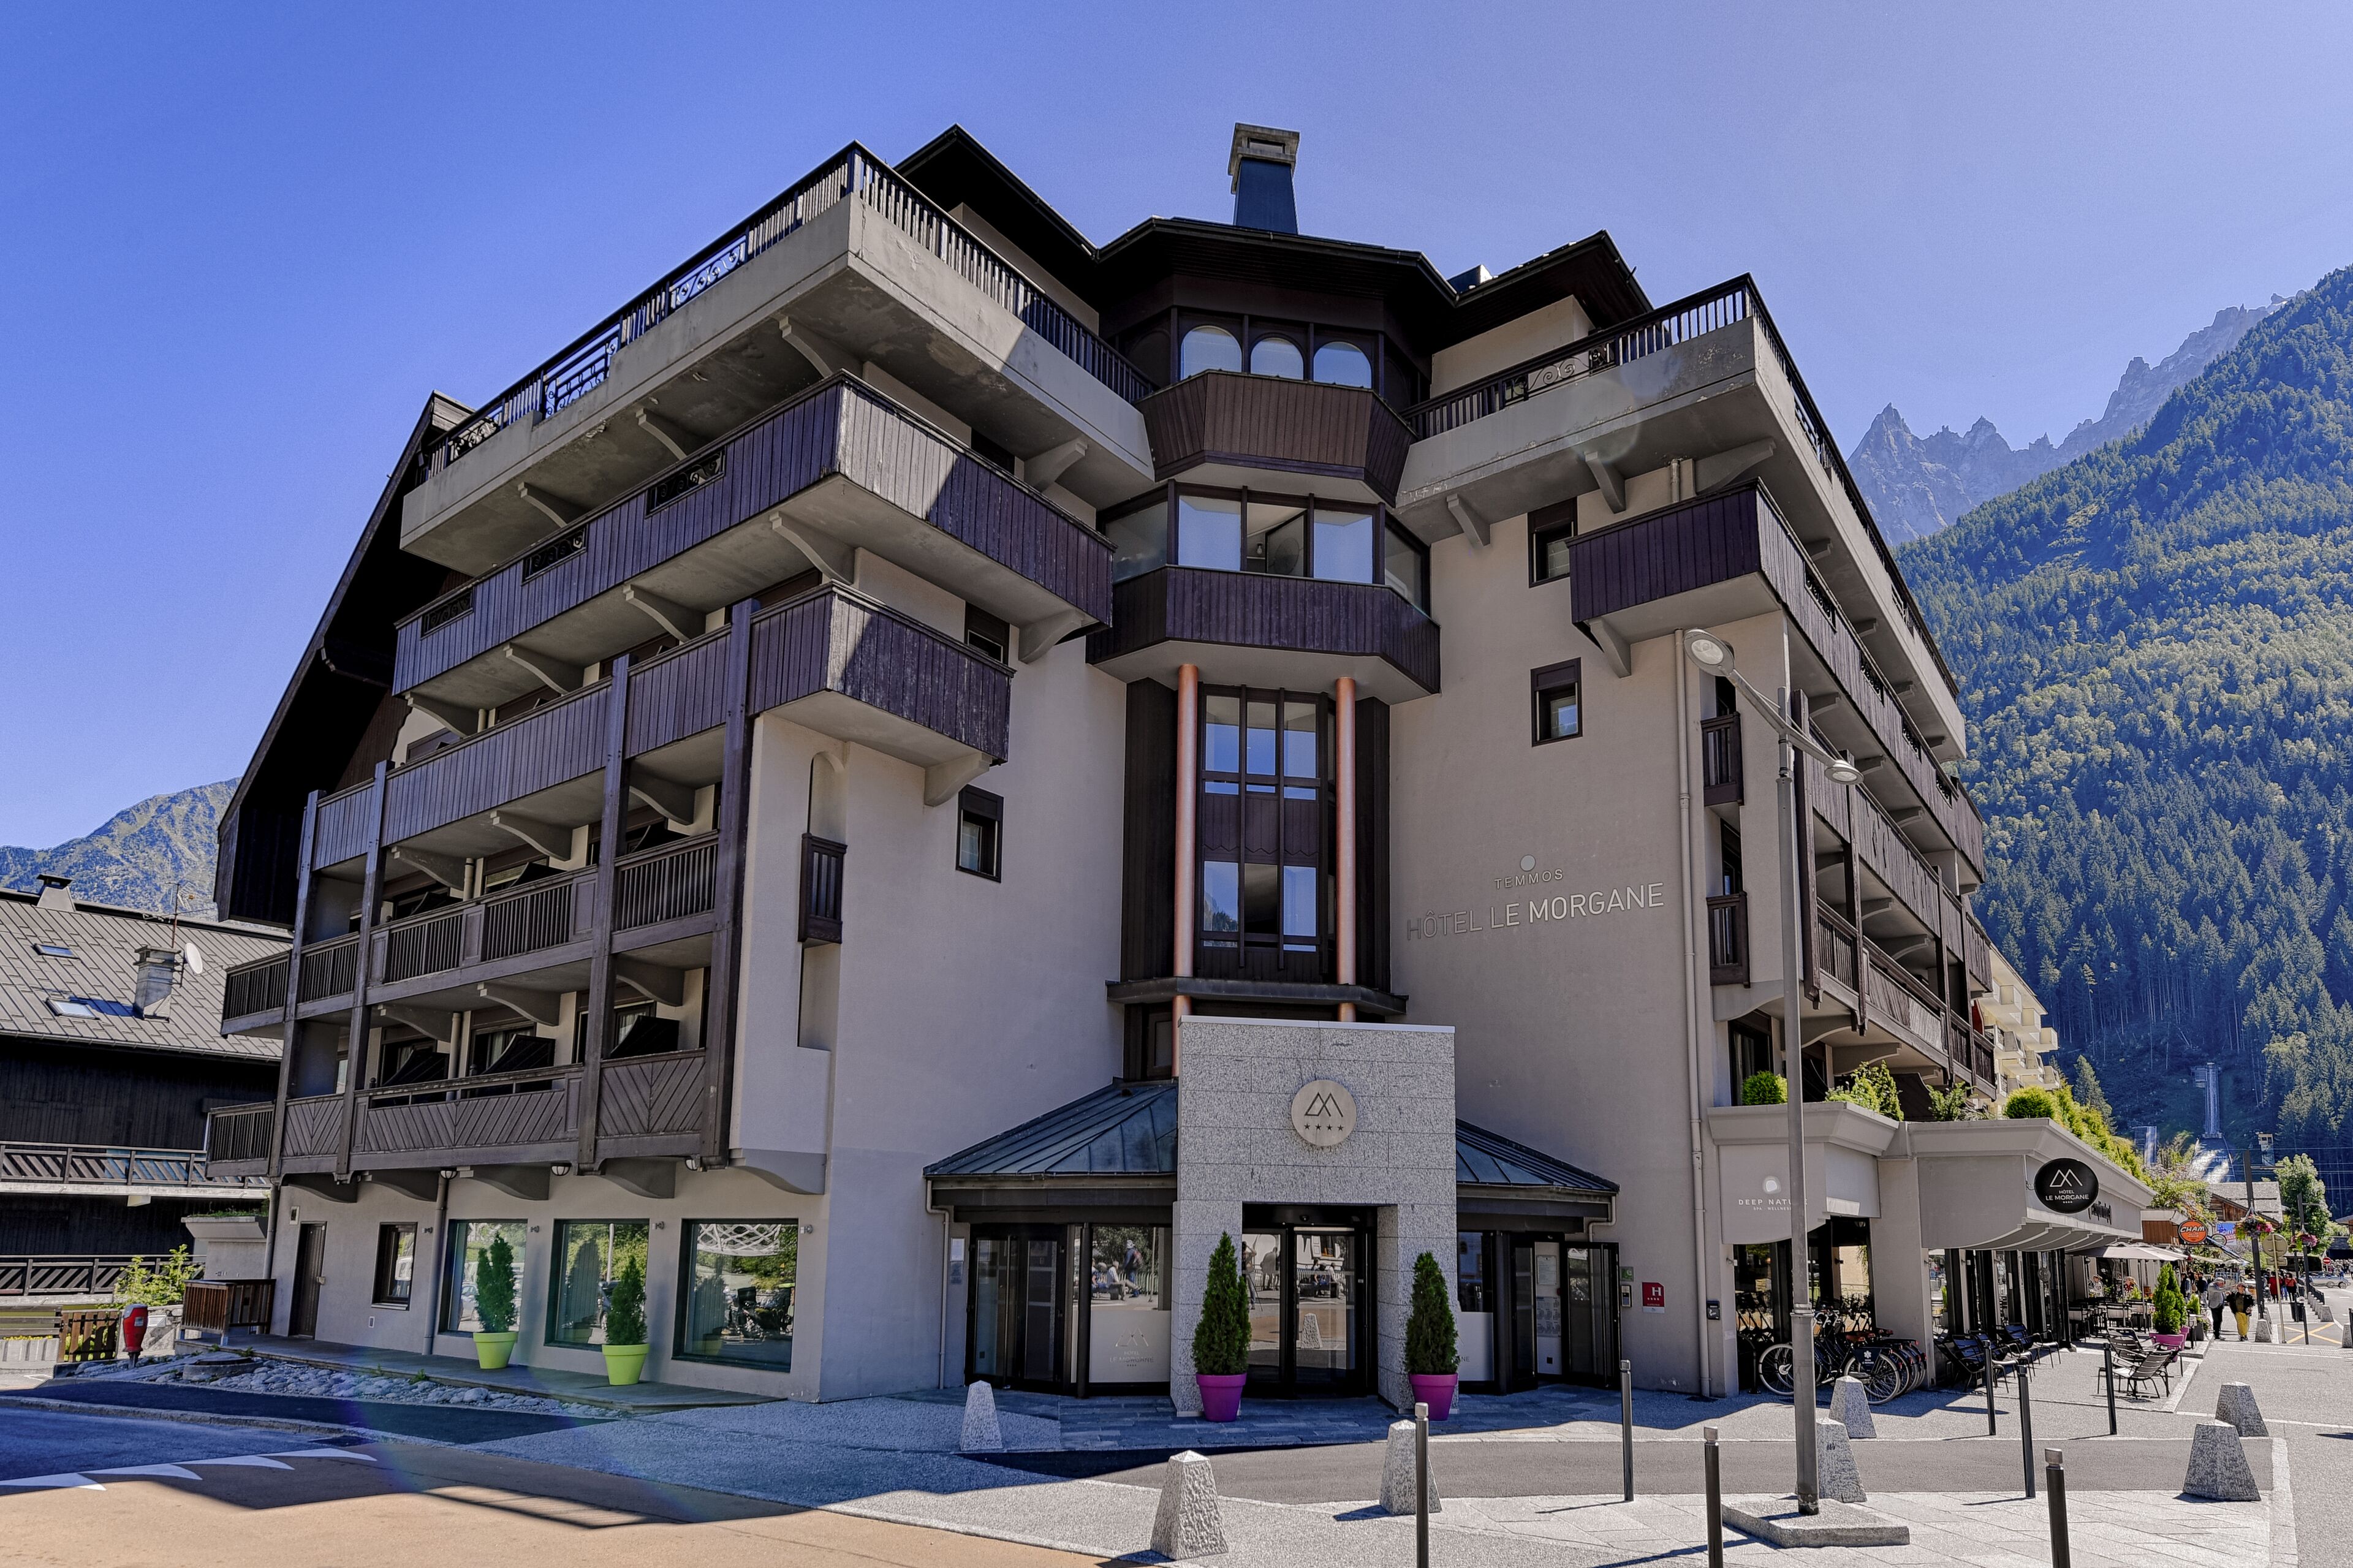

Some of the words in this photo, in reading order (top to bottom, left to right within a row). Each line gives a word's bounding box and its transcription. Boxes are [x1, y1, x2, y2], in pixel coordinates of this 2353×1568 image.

[1494, 869, 1563, 889] TEMMOS
[1407, 910, 1483, 941] HÔTEL
[1490, 902, 1520, 929] LE
[1529, 882, 1664, 923] MORGANE
[1651, 1287, 1662, 1296] H
